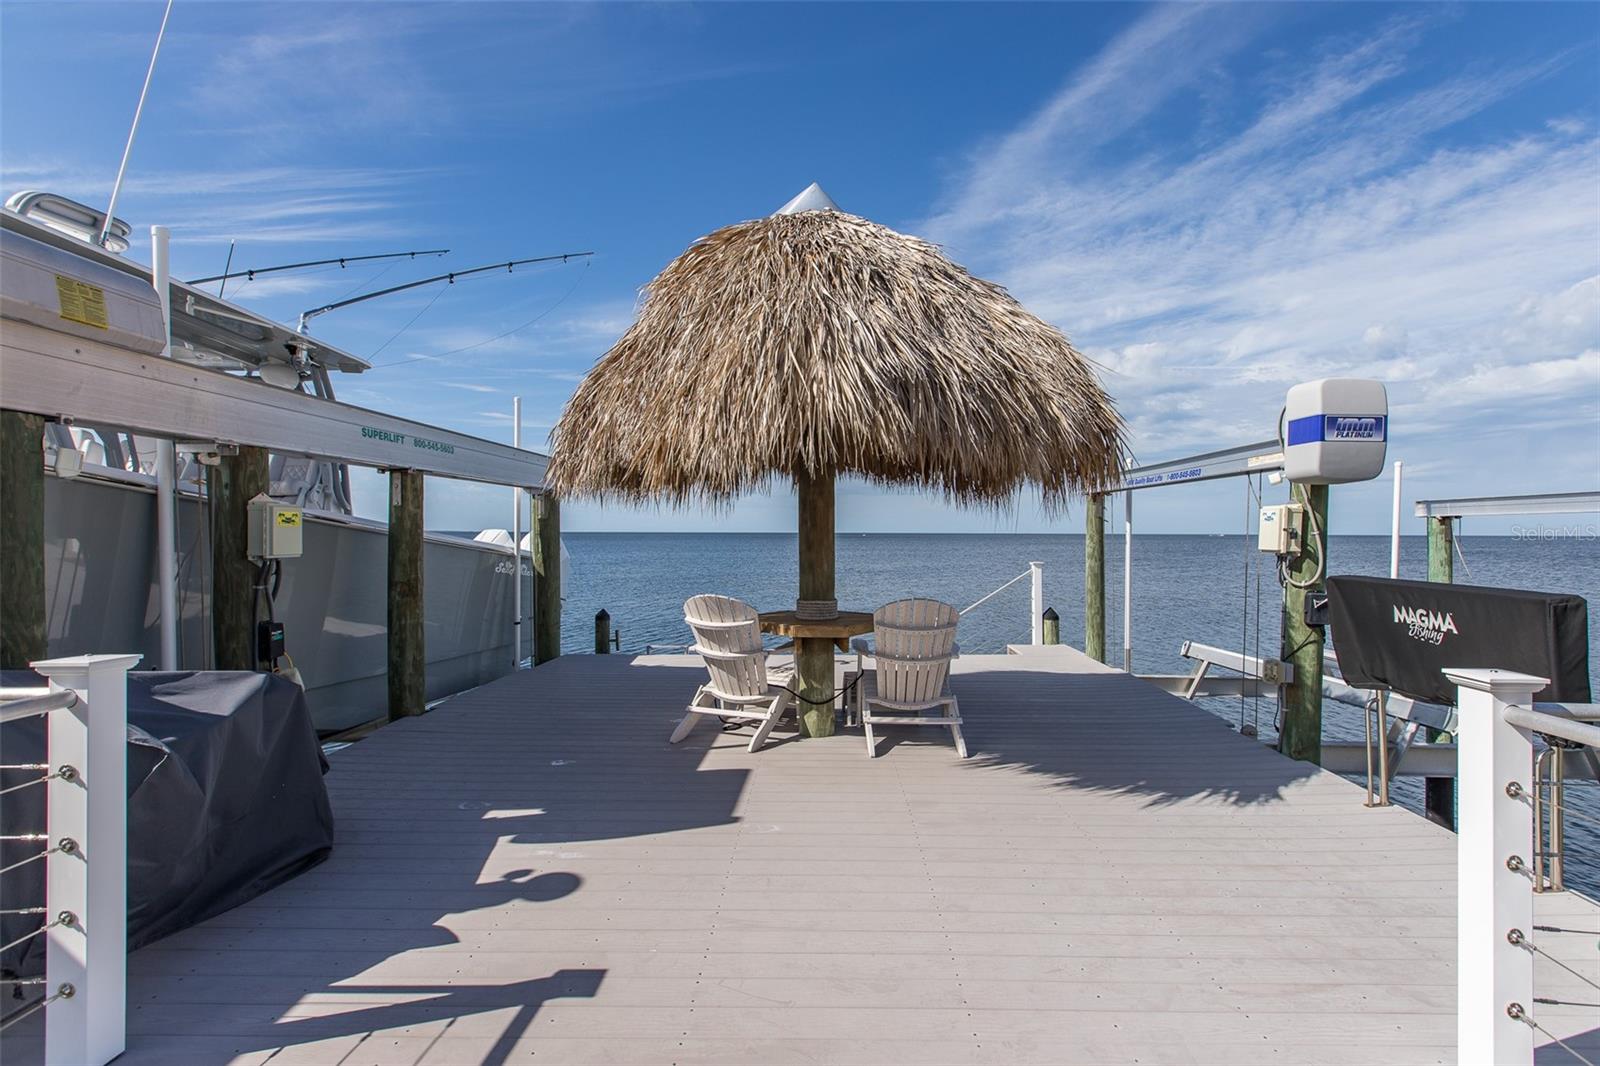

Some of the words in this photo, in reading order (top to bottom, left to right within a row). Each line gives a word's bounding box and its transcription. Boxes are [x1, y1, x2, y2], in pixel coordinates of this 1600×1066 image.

[361, 427, 405, 445] SUPERLIFT
[1335, 431, 1374, 439] PLATINUM
[1393, 604, 1458, 634] MAGMA
